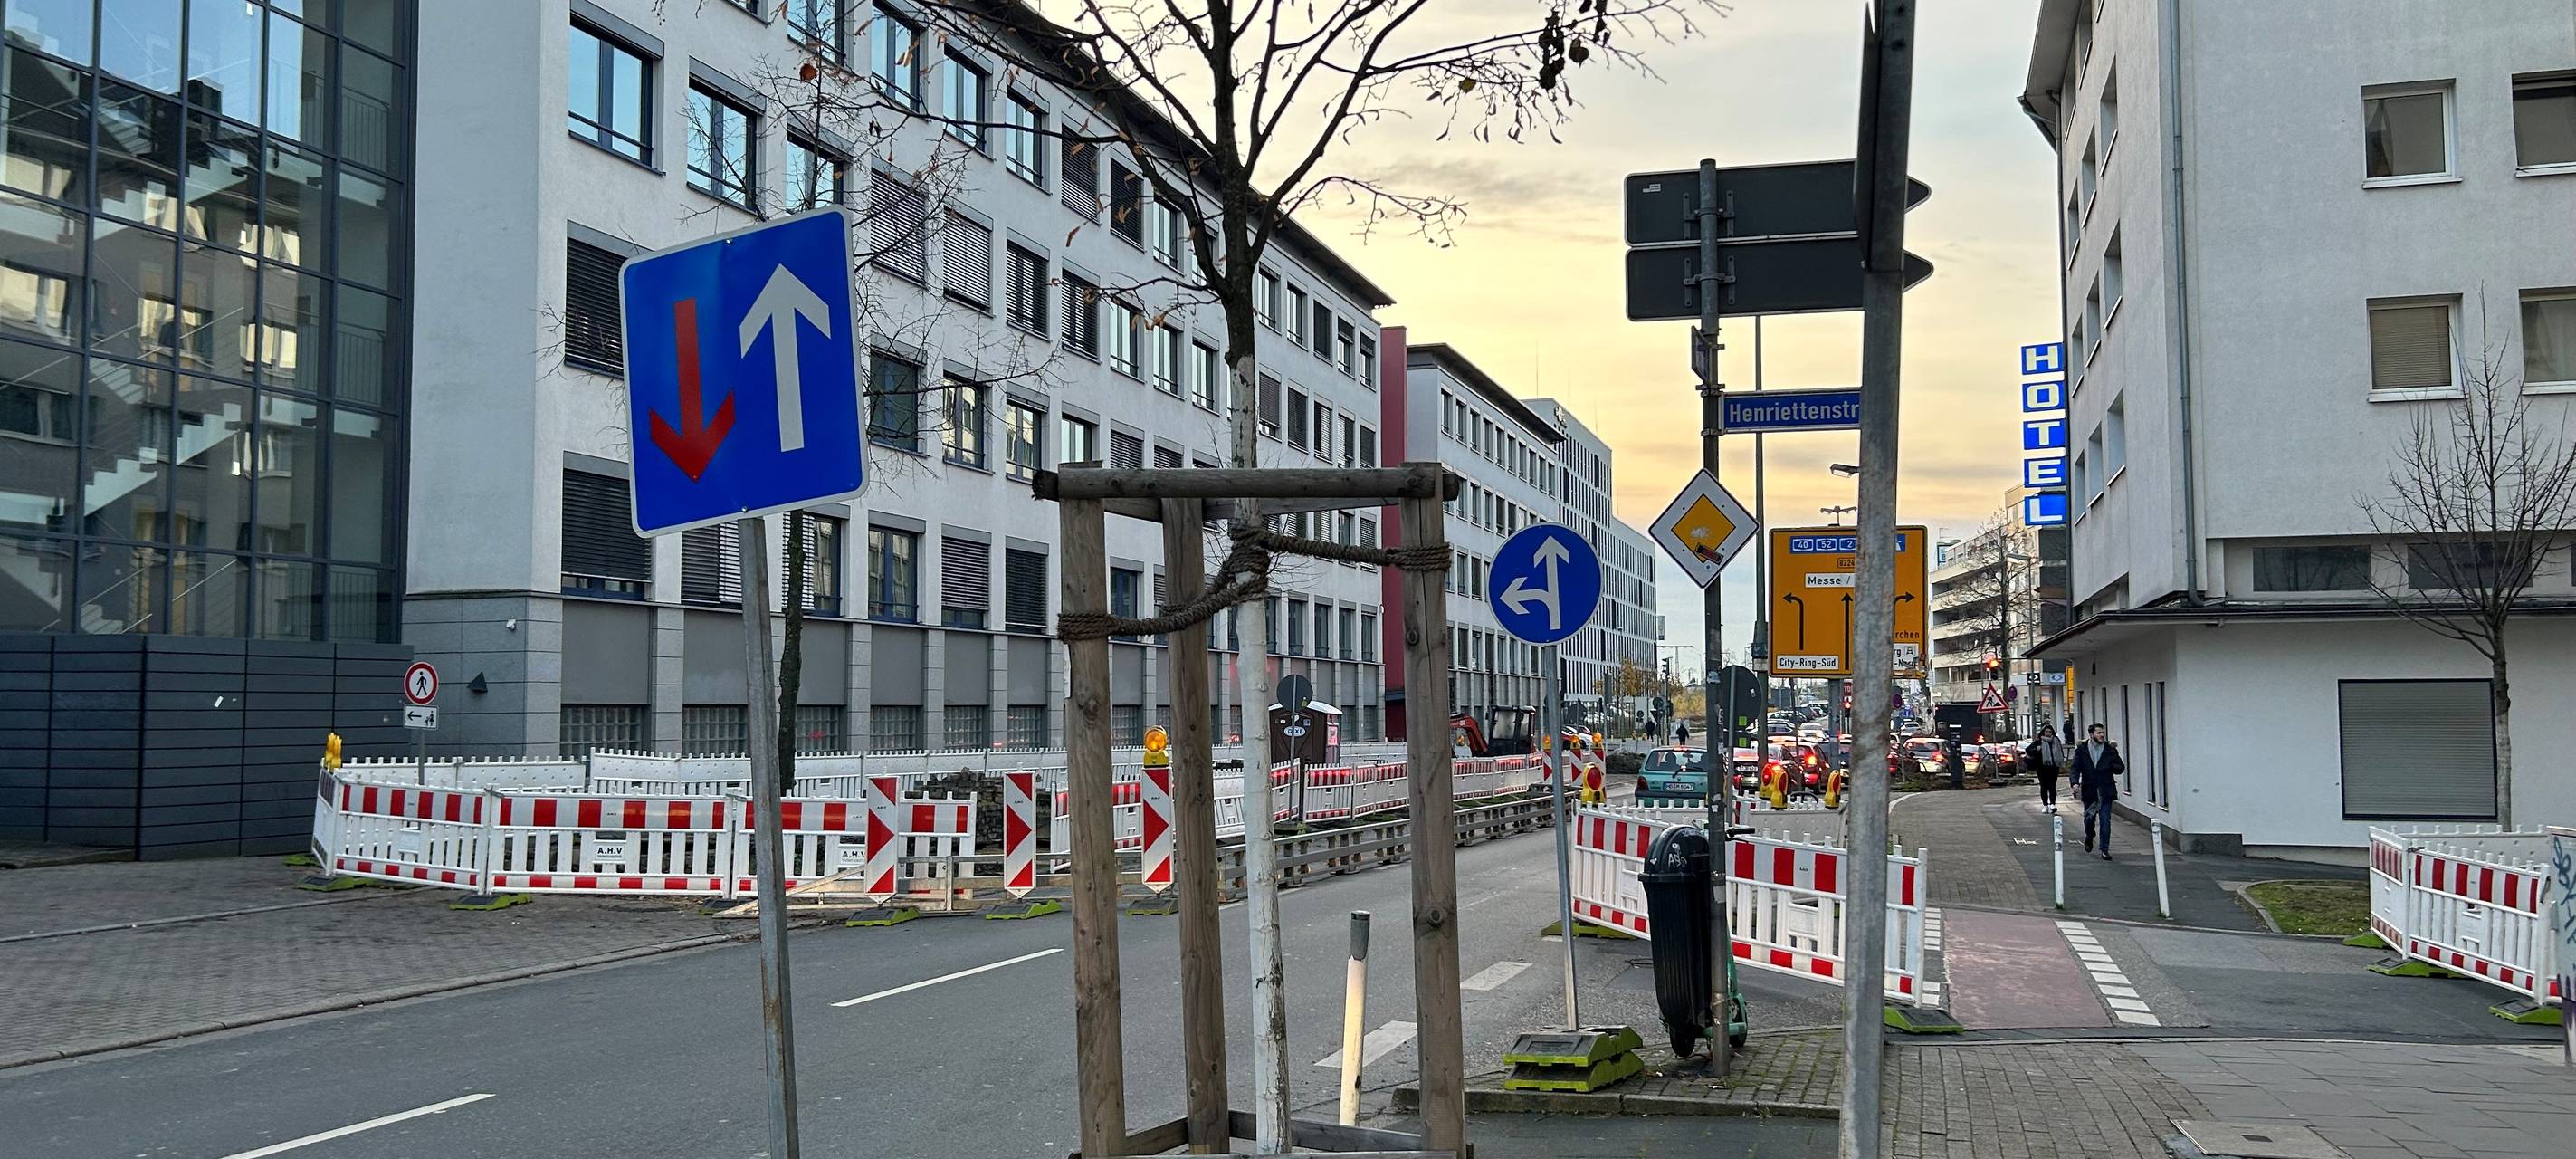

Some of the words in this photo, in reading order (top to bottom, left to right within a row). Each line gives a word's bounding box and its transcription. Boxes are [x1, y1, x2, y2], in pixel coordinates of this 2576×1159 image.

[2025, 345, 2063, 522] HOTEL
[1798, 541, 1808, 549] 40
[1821, 541, 1832, 549] 52
[1808, 576, 1841, 585] Messe
[1779, 657, 1837, 669] City-Ring-Süd
[597, 847, 623, 855] A.H.V
